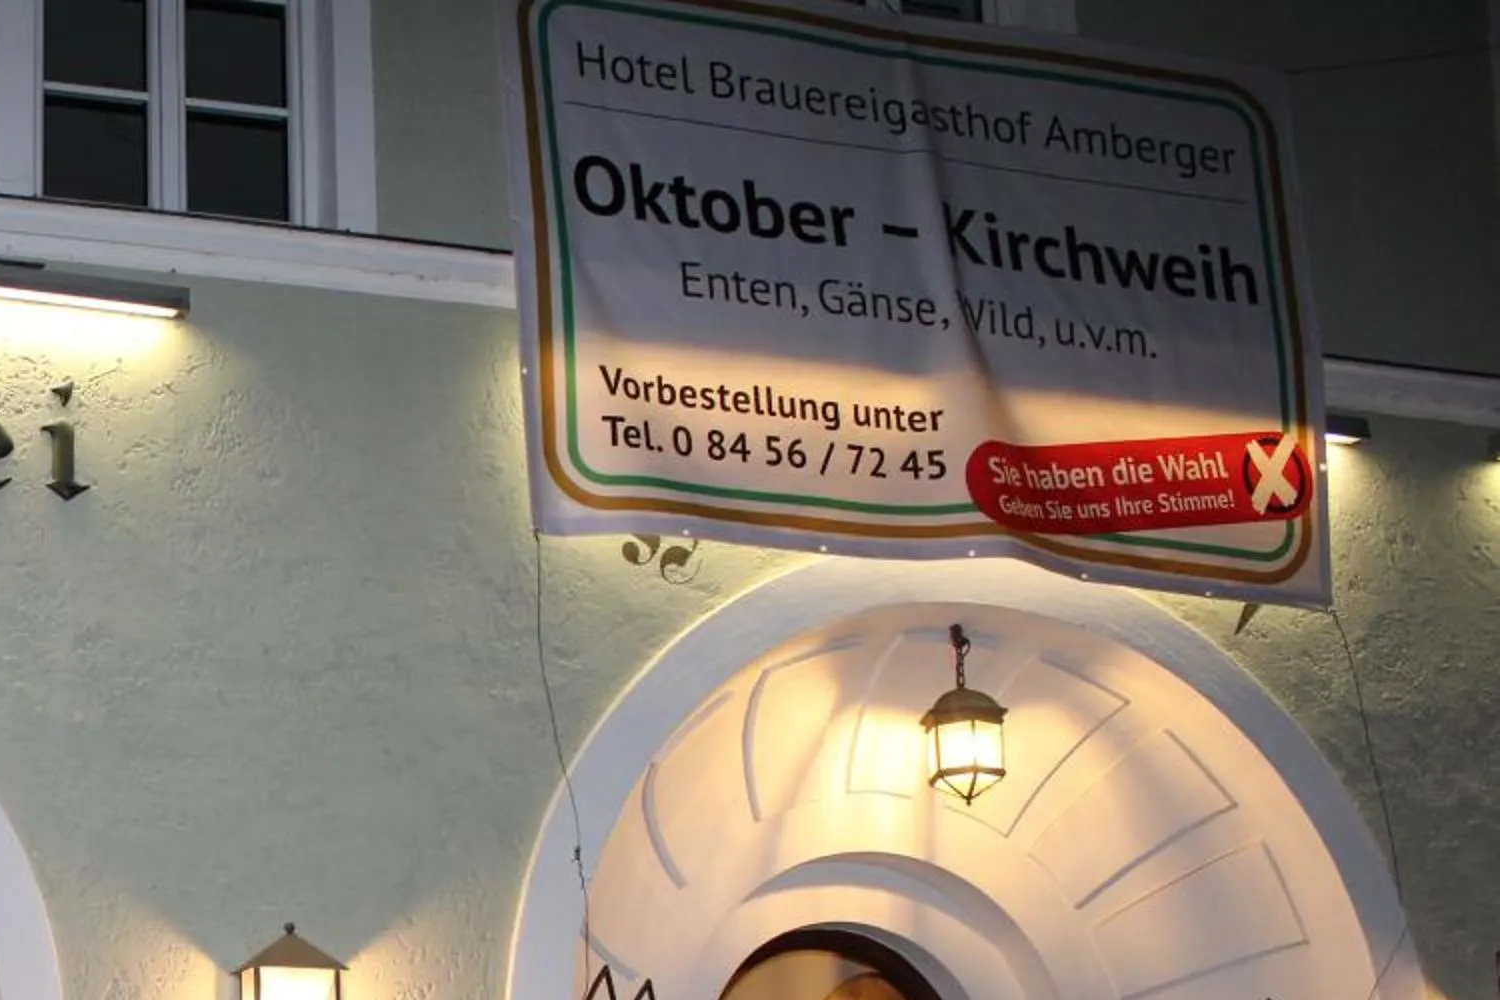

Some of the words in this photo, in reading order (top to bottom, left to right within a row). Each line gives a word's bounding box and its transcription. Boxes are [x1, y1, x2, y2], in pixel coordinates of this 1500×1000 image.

[576, 40, 695, 94] Hotel
[709, 60, 1033, 145] Brauereigasthof
[1044, 115, 1236, 179] Amberger
[573, 154, 856, 248] Oktober
[942, 201, 1260, 305] Kirchweih
[680, 261, 810, 318] Enten,
[818, 277, 950, 331] Gänse,
[1055, 317, 1158, 360] u.v.m.
[598, 364, 841, 430] Vorbestellung
[853, 402, 945, 433] unter
[601, 415, 664, 453] Tel.
[672, 425, 693, 457] 0
[707, 429, 752, 463] 84
[765, 435, 807, 469] 56
[819, 442, 835, 475] /
[846, 444, 888, 478] 72
[899, 450, 947, 480] 45
[989, 456, 1022, 487] Sie
[1022, 462, 1105, 491] haben
[1111, 457, 1152, 486] die
[1156, 451, 1229, 483] Wahl
[1000, 494, 1046, 518] Geben
[1045, 500, 1073, 520] Sie
[1077, 500, 1111, 518] uns
[1115, 496, 1154, 517] Ihre
[1156, 489, 1235, 514] Stimme!
